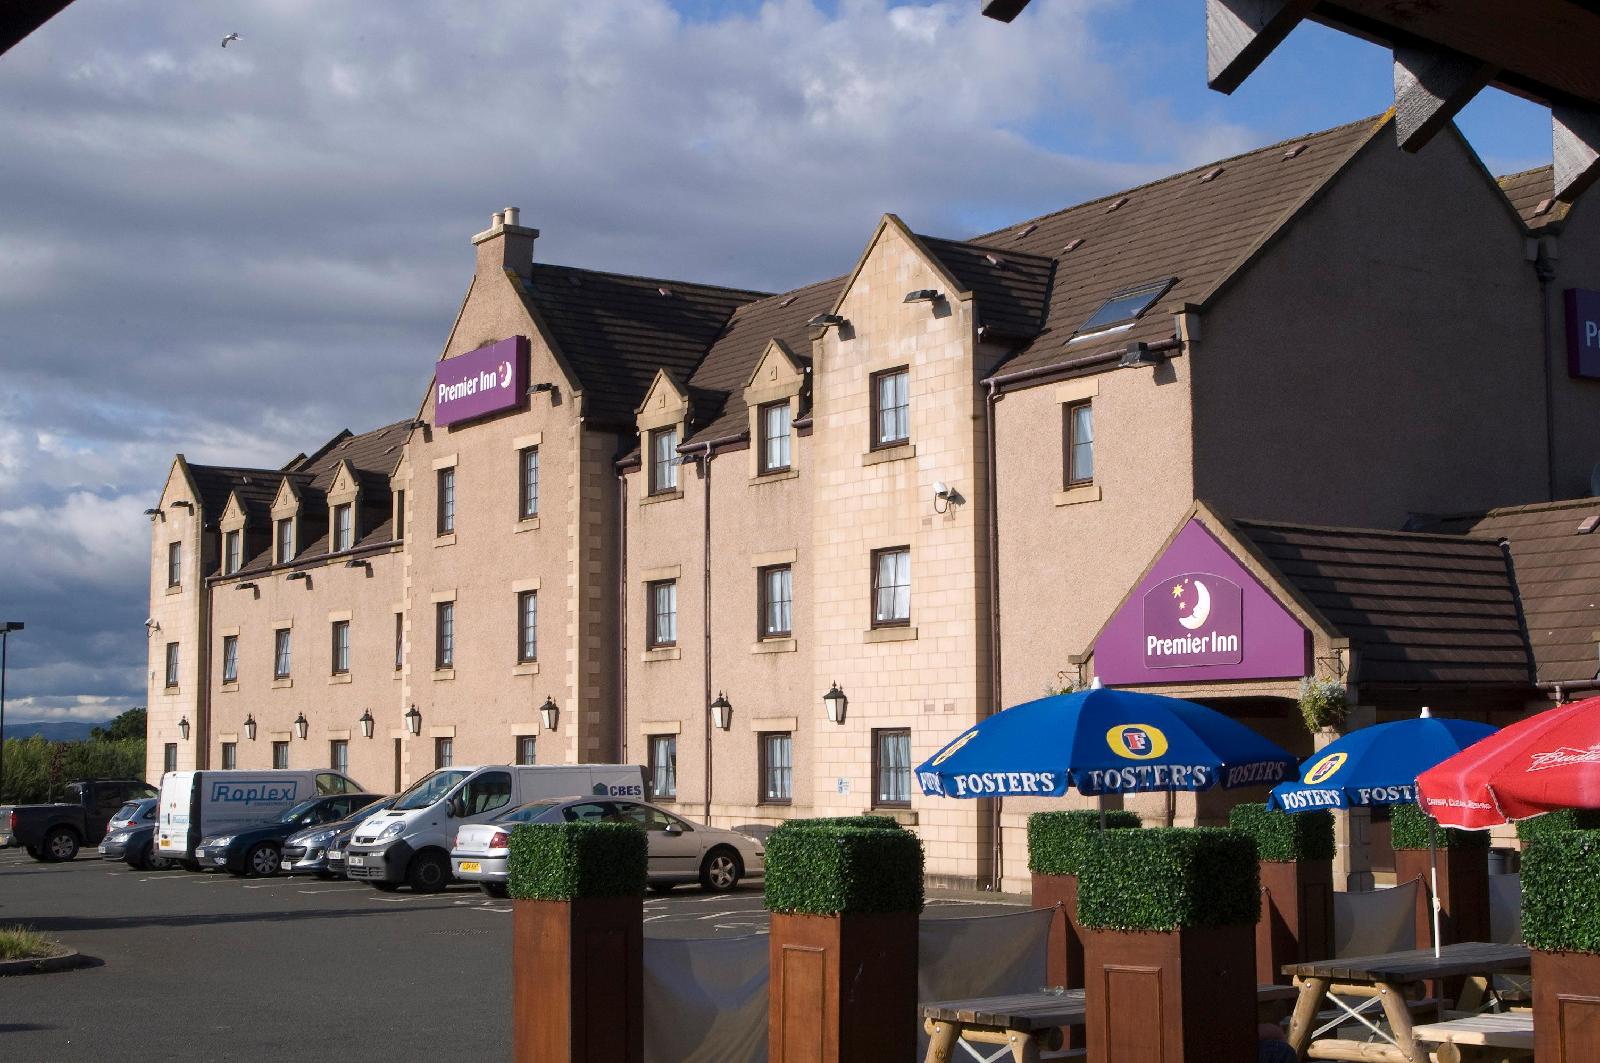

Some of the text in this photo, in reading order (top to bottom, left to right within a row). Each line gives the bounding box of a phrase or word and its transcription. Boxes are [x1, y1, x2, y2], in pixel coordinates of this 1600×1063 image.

[438, 370, 497, 404] Premier Inn
[1147, 631, 1238, 656] Premier Inn
[954, 772, 1055, 796] FOSTER'S
[1088, 764, 1208, 791] FOSTER'S
[1226, 761, 1287, 788] FOSTER'S
[609, 785, 642, 797] CBES
[1281, 789, 1341, 810] FOSTER'S
[1358, 785, 1418, 805] FOST
